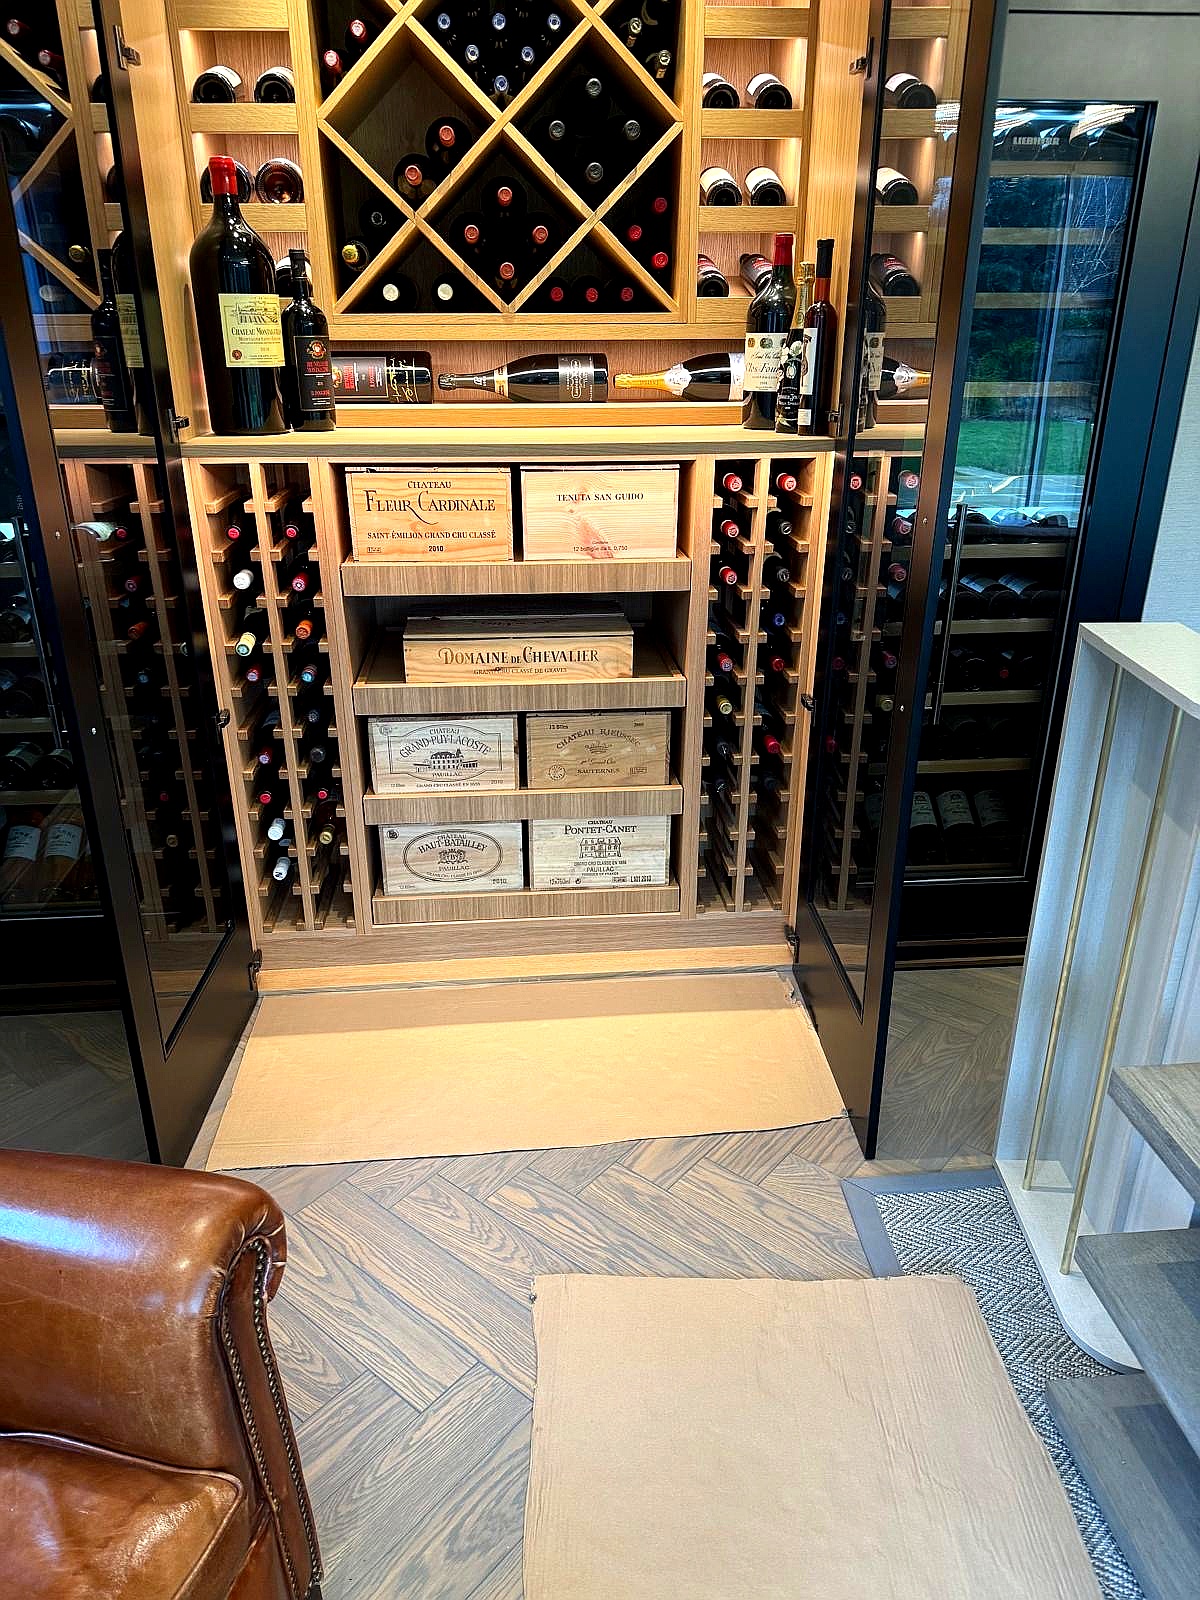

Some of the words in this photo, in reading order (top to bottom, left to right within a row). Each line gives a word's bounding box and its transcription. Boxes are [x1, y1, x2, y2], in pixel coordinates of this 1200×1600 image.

[407, 480, 451, 488] CHATEAU
[418, 490, 496, 512] CARDINALE
[556, 494, 591, 502] TENUTA
[469, 530, 496, 538] CLASSÉ
[438, 647, 508, 665] DOMAINE
[511, 655, 522, 664] DE
[522, 646, 599, 664] CHEVALIER
[556, 729, 594, 750] CHATEAU
[564, 825, 637, 834] PONTET-CANET
[418, 839, 488, 854] HAUT-BATAILLEY
